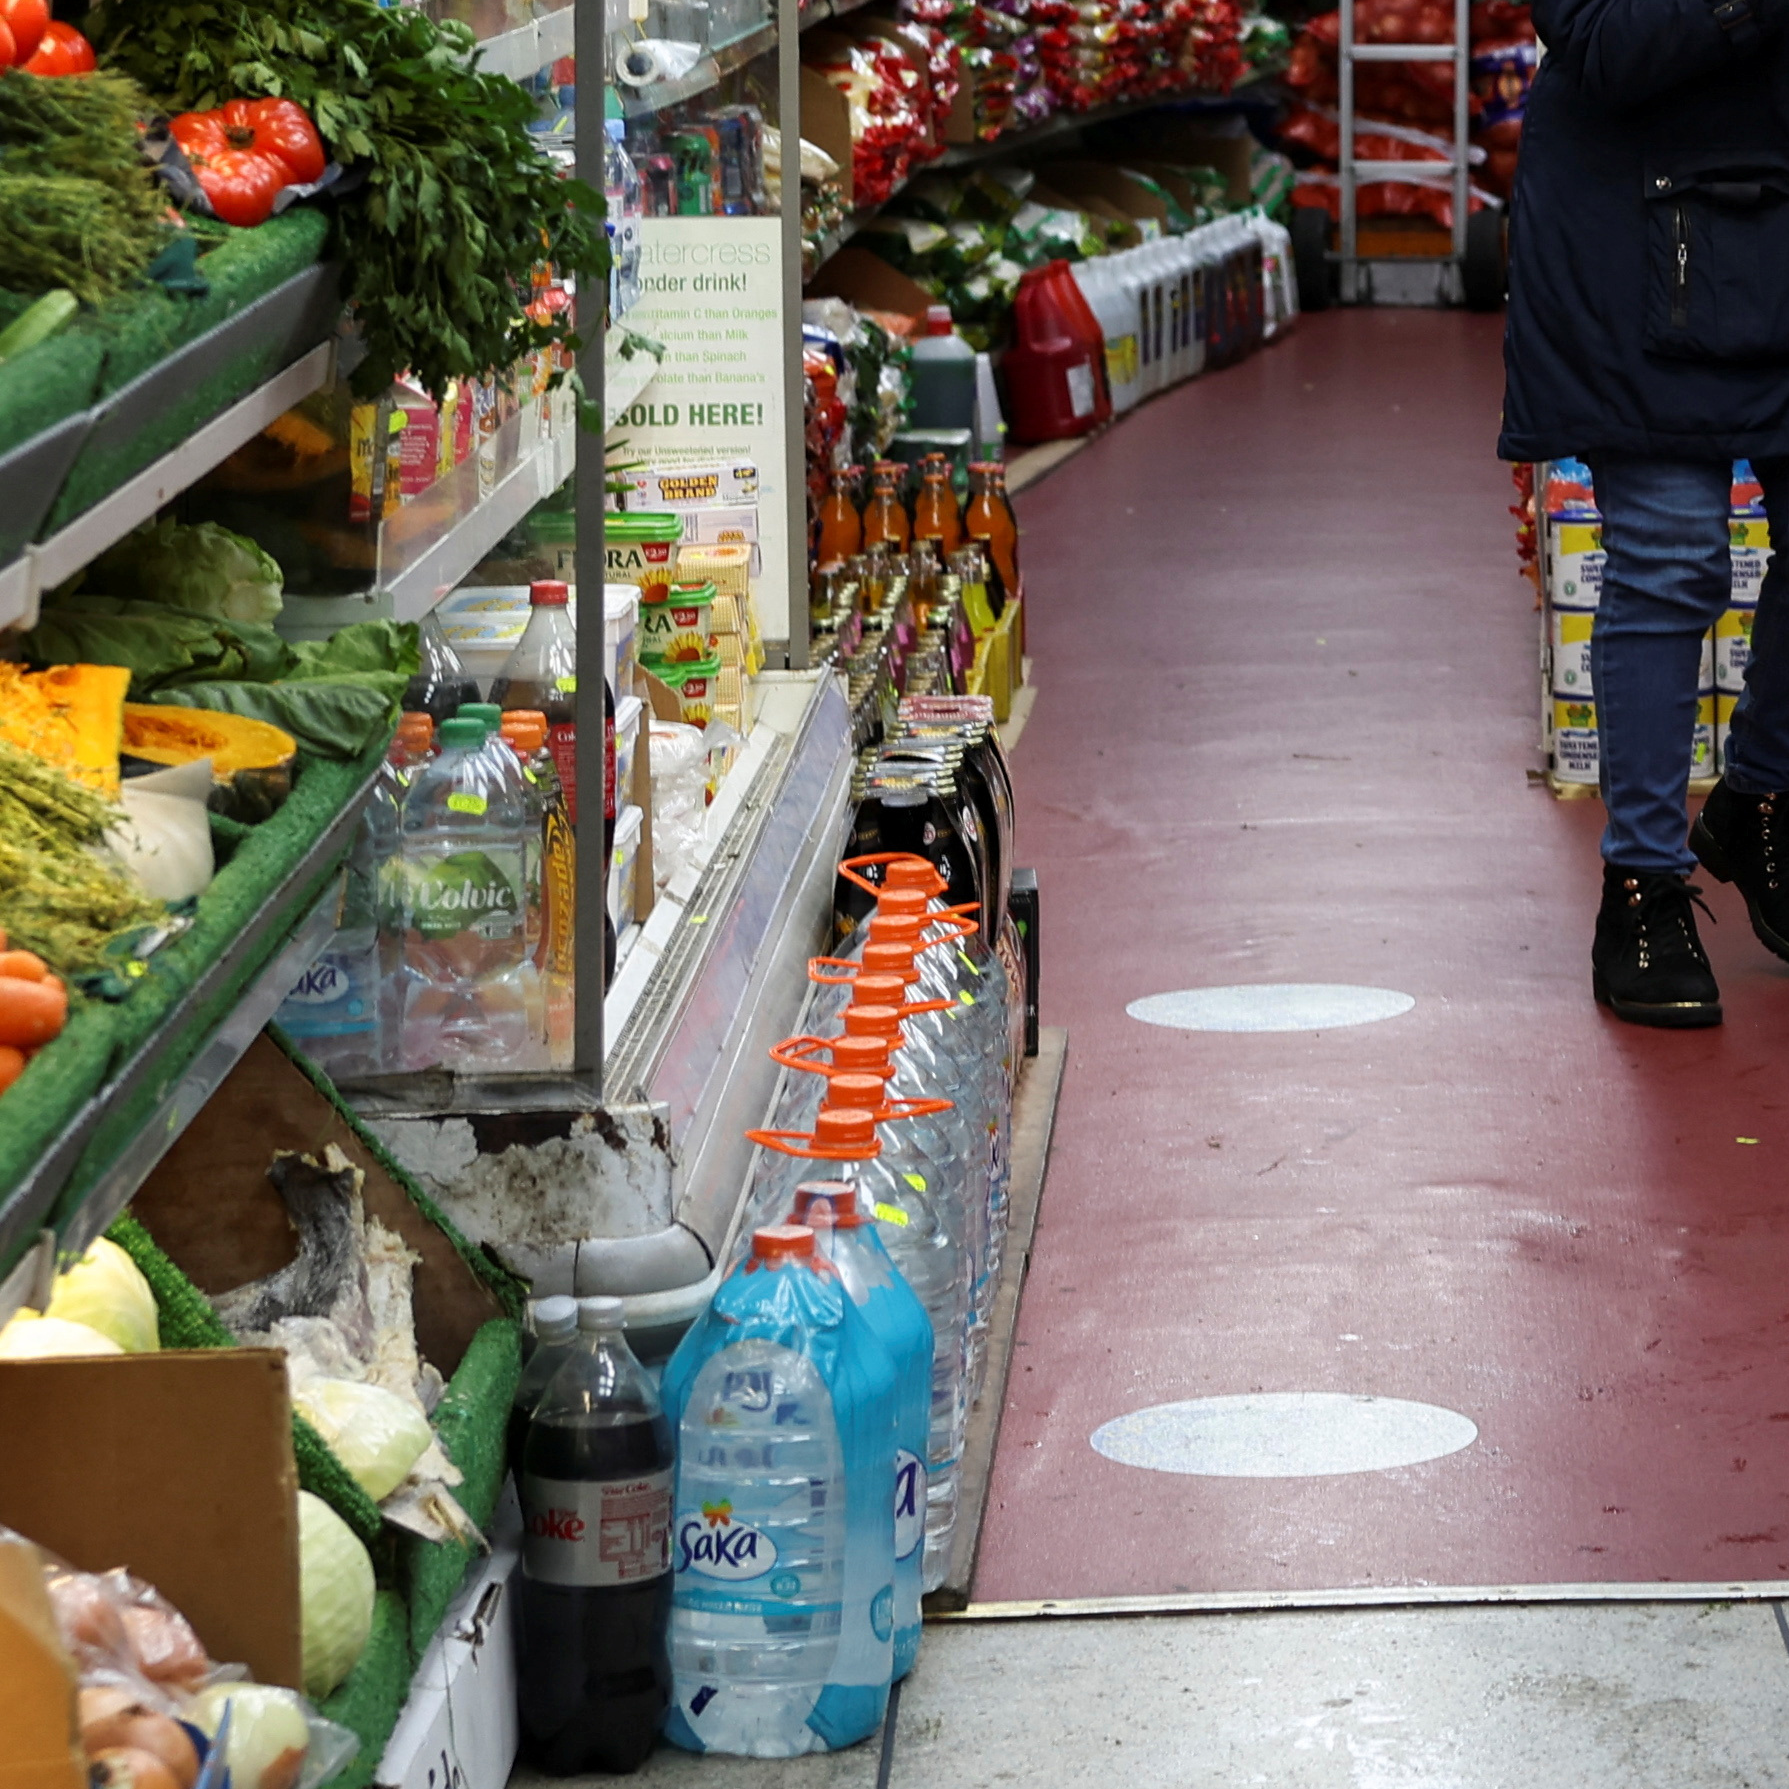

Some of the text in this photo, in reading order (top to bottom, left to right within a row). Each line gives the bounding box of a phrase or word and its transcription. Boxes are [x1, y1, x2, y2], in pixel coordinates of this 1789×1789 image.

[692, 272, 748, 293] drink!
[702, 307, 778, 323] than Oranges
[697, 329, 749, 342] than Milk
[674, 350, 747, 365] than Spinach
[686, 371, 766, 384] than Banana's
[688, 404, 764, 426] HERE!
[658, 475, 719, 490] GOLDEN
[662, 487, 717, 501] BRAND
